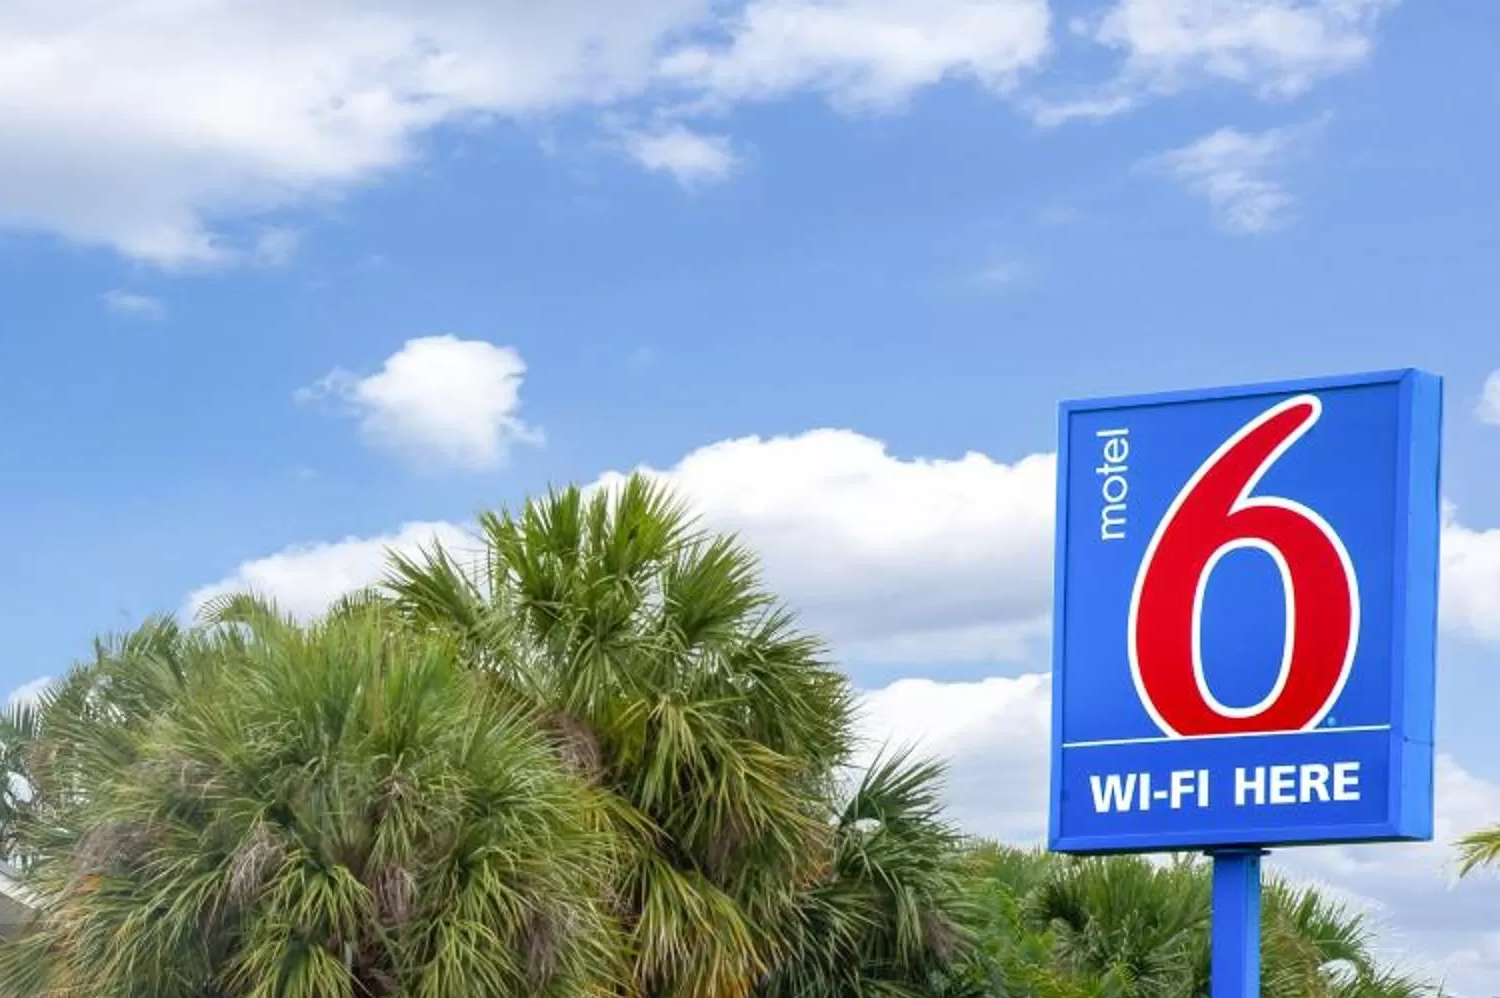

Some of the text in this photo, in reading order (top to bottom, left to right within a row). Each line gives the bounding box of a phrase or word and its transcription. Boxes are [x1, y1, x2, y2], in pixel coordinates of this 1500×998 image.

[1096, 394, 1360, 739] motel 6
[1090, 761, 1361, 813] WI-FI HERE
